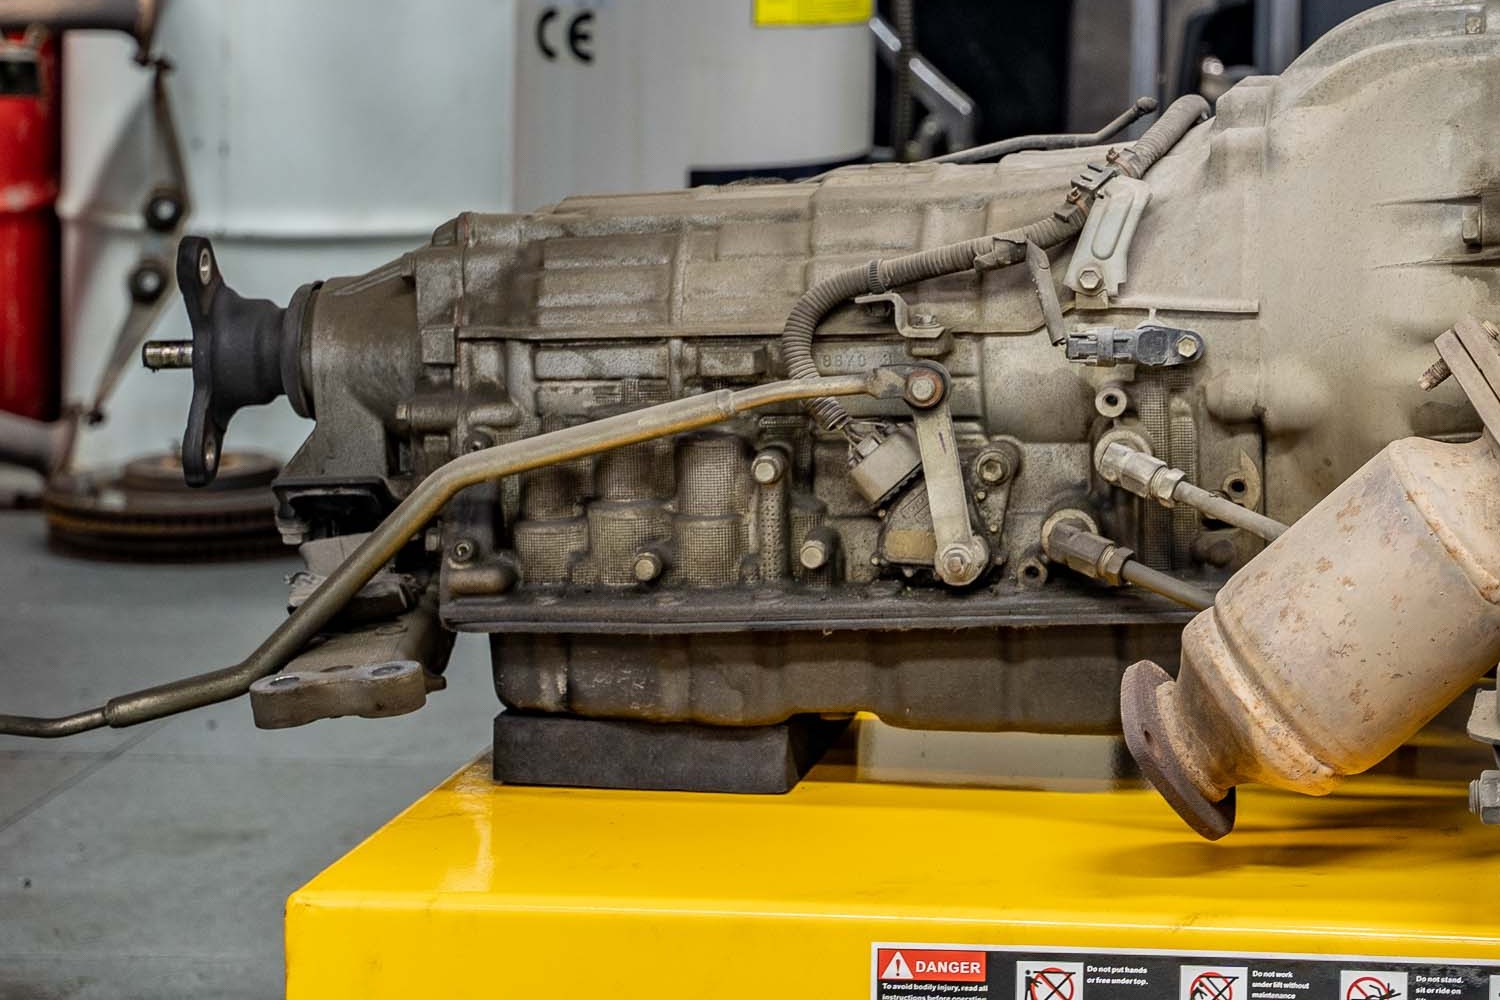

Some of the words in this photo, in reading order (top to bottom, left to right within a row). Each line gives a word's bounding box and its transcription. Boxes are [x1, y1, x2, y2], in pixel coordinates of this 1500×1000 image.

[535, 7, 597, 65] CE
[915, 960, 981, 974] DANGER
[1086, 965, 1098, 973] Do
[1111, 966, 1125, 975] put
[1124, 966, 1148, 974] hands
[1252, 970, 1263, 978] Do
[1263, 970, 1276, 978] not
[1111, 977, 1133, 985] under
[1133, 978, 1149, 986] top.
[1415, 975, 1427, 983] Do
[882, 982, 892, 990] To
[892, 982, 912, 990] avoid
[913, 983, 937, 992] bodily
[960, 984, 979, 992] read
[1272, 981, 1283, 989] lift
[1283, 981, 1310, 990] without
[1415, 986, 1426, 994] sit
[1435, 987, 1451, 995] ride
[1251, 991, 1297, 1000] maintenance
